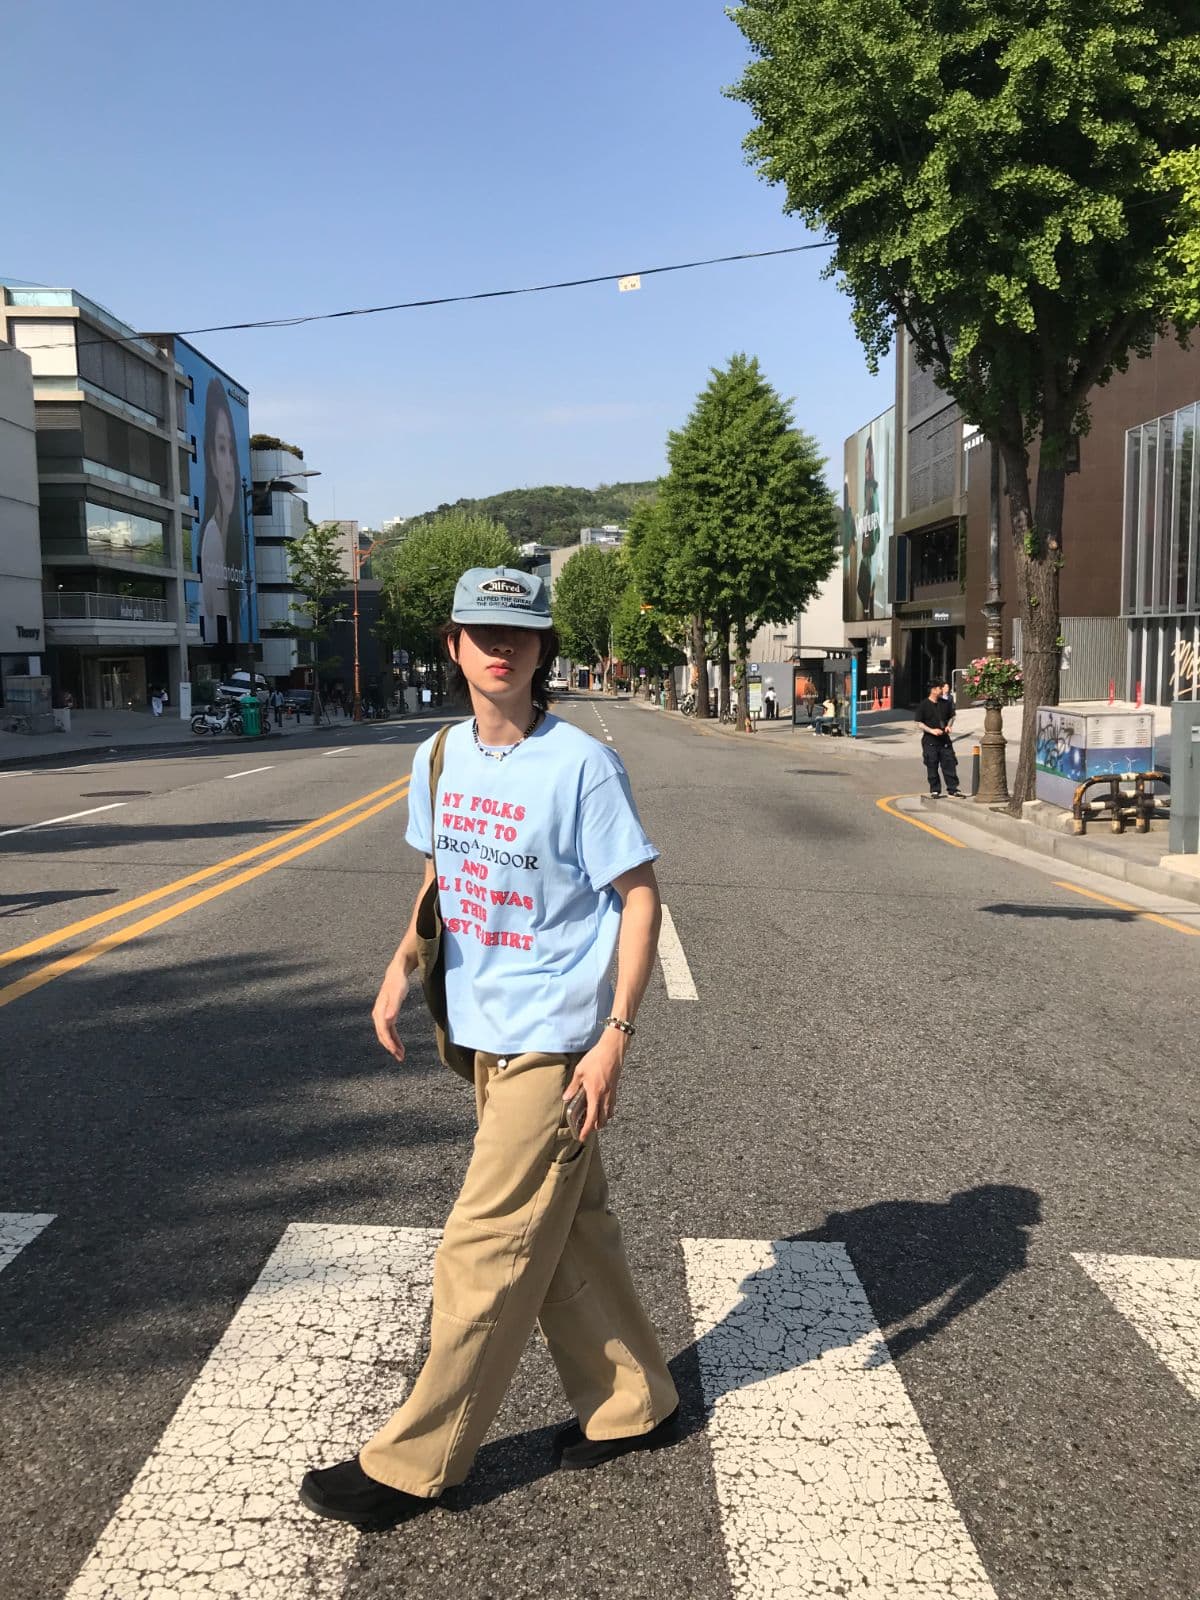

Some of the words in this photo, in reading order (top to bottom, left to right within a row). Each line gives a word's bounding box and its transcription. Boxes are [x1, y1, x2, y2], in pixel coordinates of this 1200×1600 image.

[488, 581, 521, 593] Alfred
[470, 796, 526, 821] FOLKS
[442, 813, 488, 835] WENT
[494, 823, 517, 842] TO
[436, 835, 539, 870] BROADMOOR
[461, 858, 489, 880] AND
[454, 877, 462, 892] I
[465, 880, 487, 902] GOT
[490, 889, 534, 911] WAS
